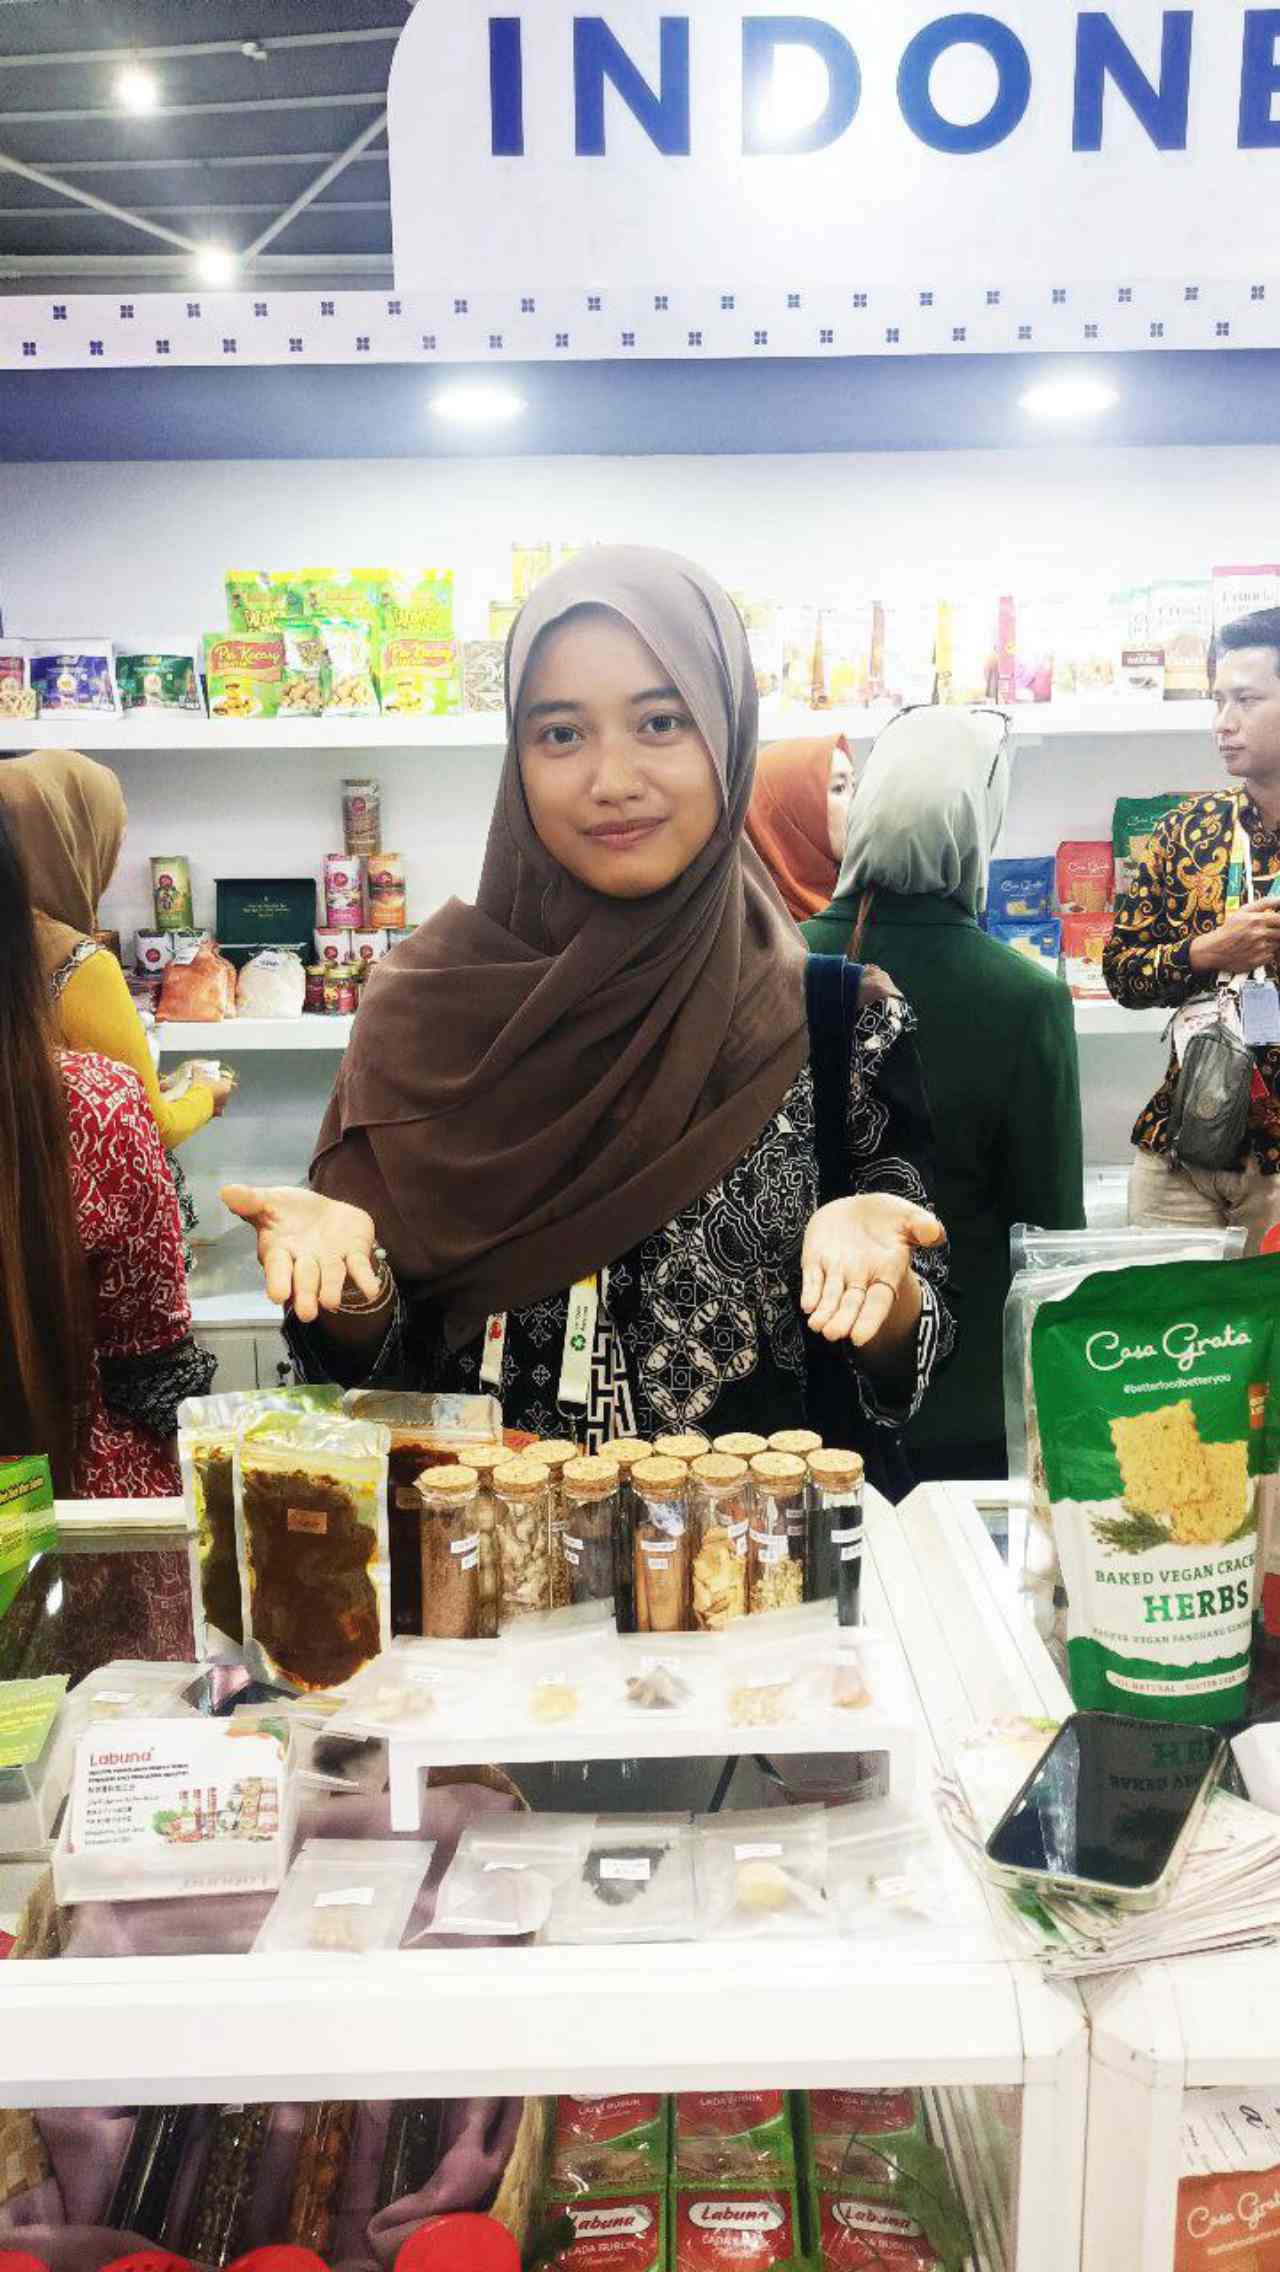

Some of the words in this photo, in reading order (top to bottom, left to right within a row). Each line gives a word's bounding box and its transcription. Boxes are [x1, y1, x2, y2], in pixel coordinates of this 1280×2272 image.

[1086, 1330, 1158, 1371] Casa
[1162, 1323, 1252, 1372] Grata
[1095, 1569, 1154, 1586] BAKED
[1159, 1562, 1214, 1583] VEGAN
[1143, 1580, 1249, 1623] HERBS
[90, 1750, 152, 1767] Labuna
[700, 2205, 769, 2222] Labuna
[1187, 2205, 1235, 2239] Casa
